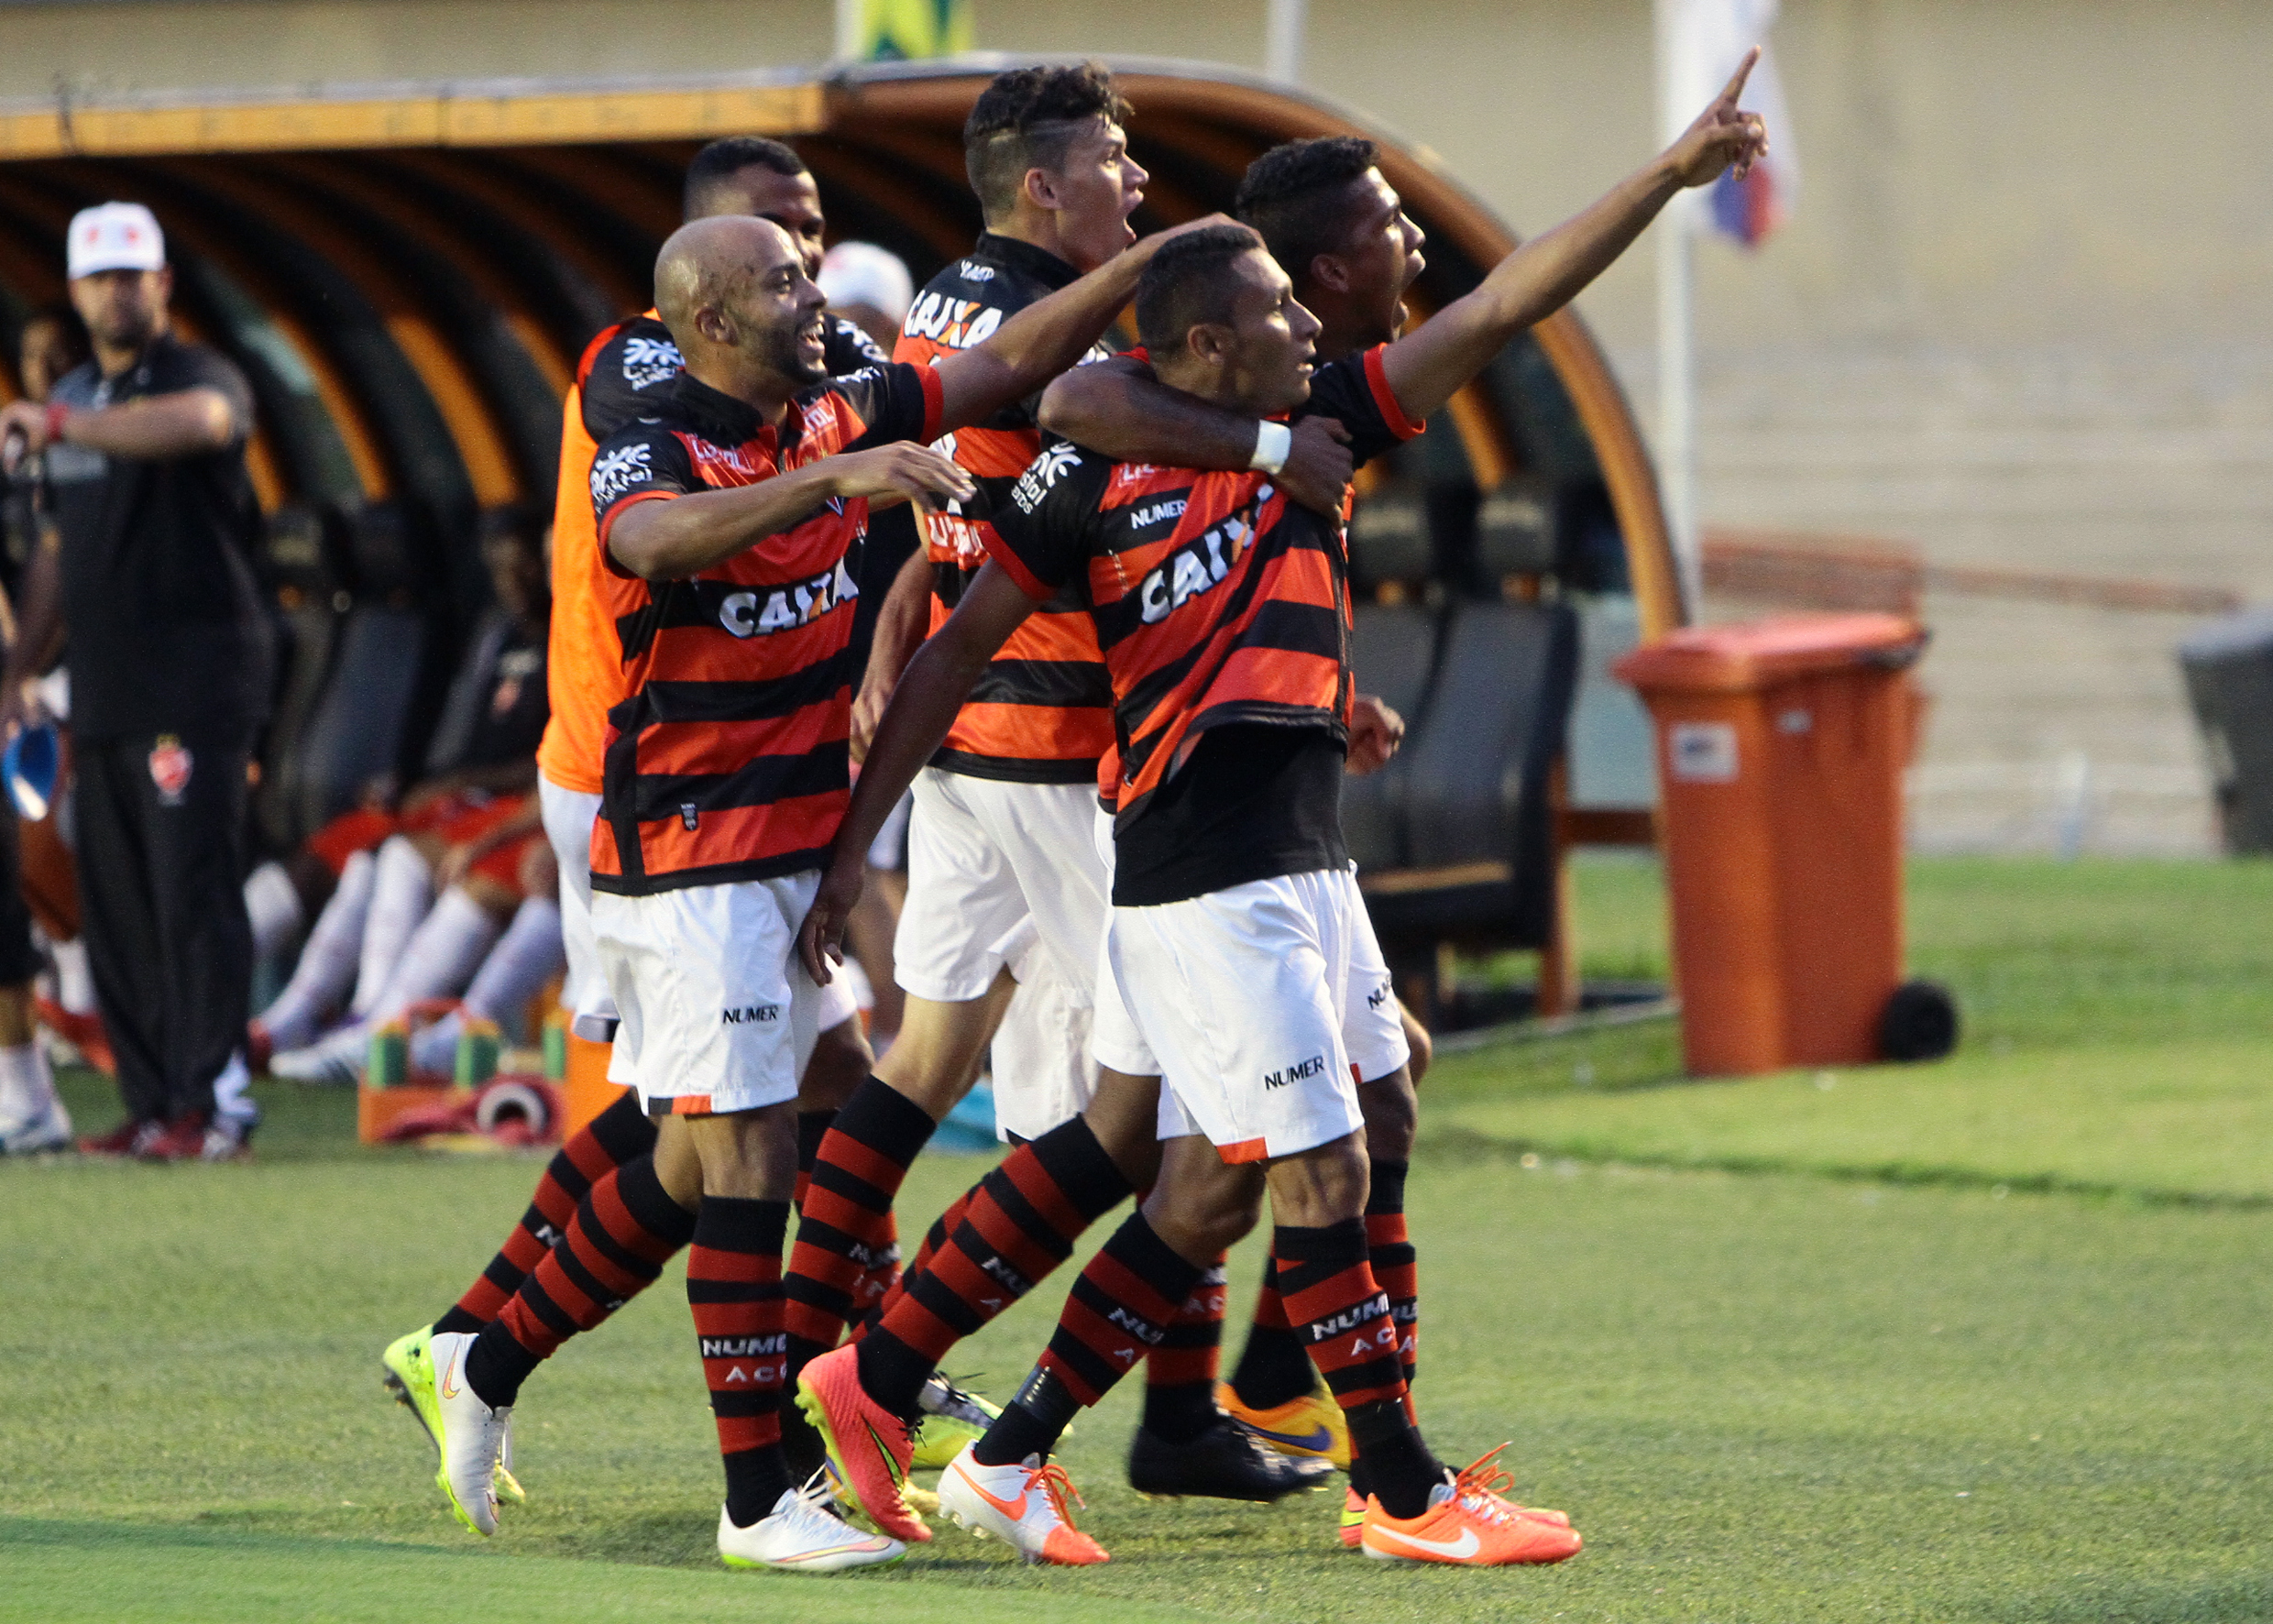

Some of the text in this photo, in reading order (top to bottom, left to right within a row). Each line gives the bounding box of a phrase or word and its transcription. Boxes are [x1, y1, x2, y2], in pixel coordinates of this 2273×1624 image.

[1130, 499, 1188, 530] NUMER
[719, 556, 860, 640] CAIXA
[723, 1004, 779, 1025] NUMER
[1265, 1056, 1324, 1091] NUMER
[1351, 1325, 1397, 1357] AC
